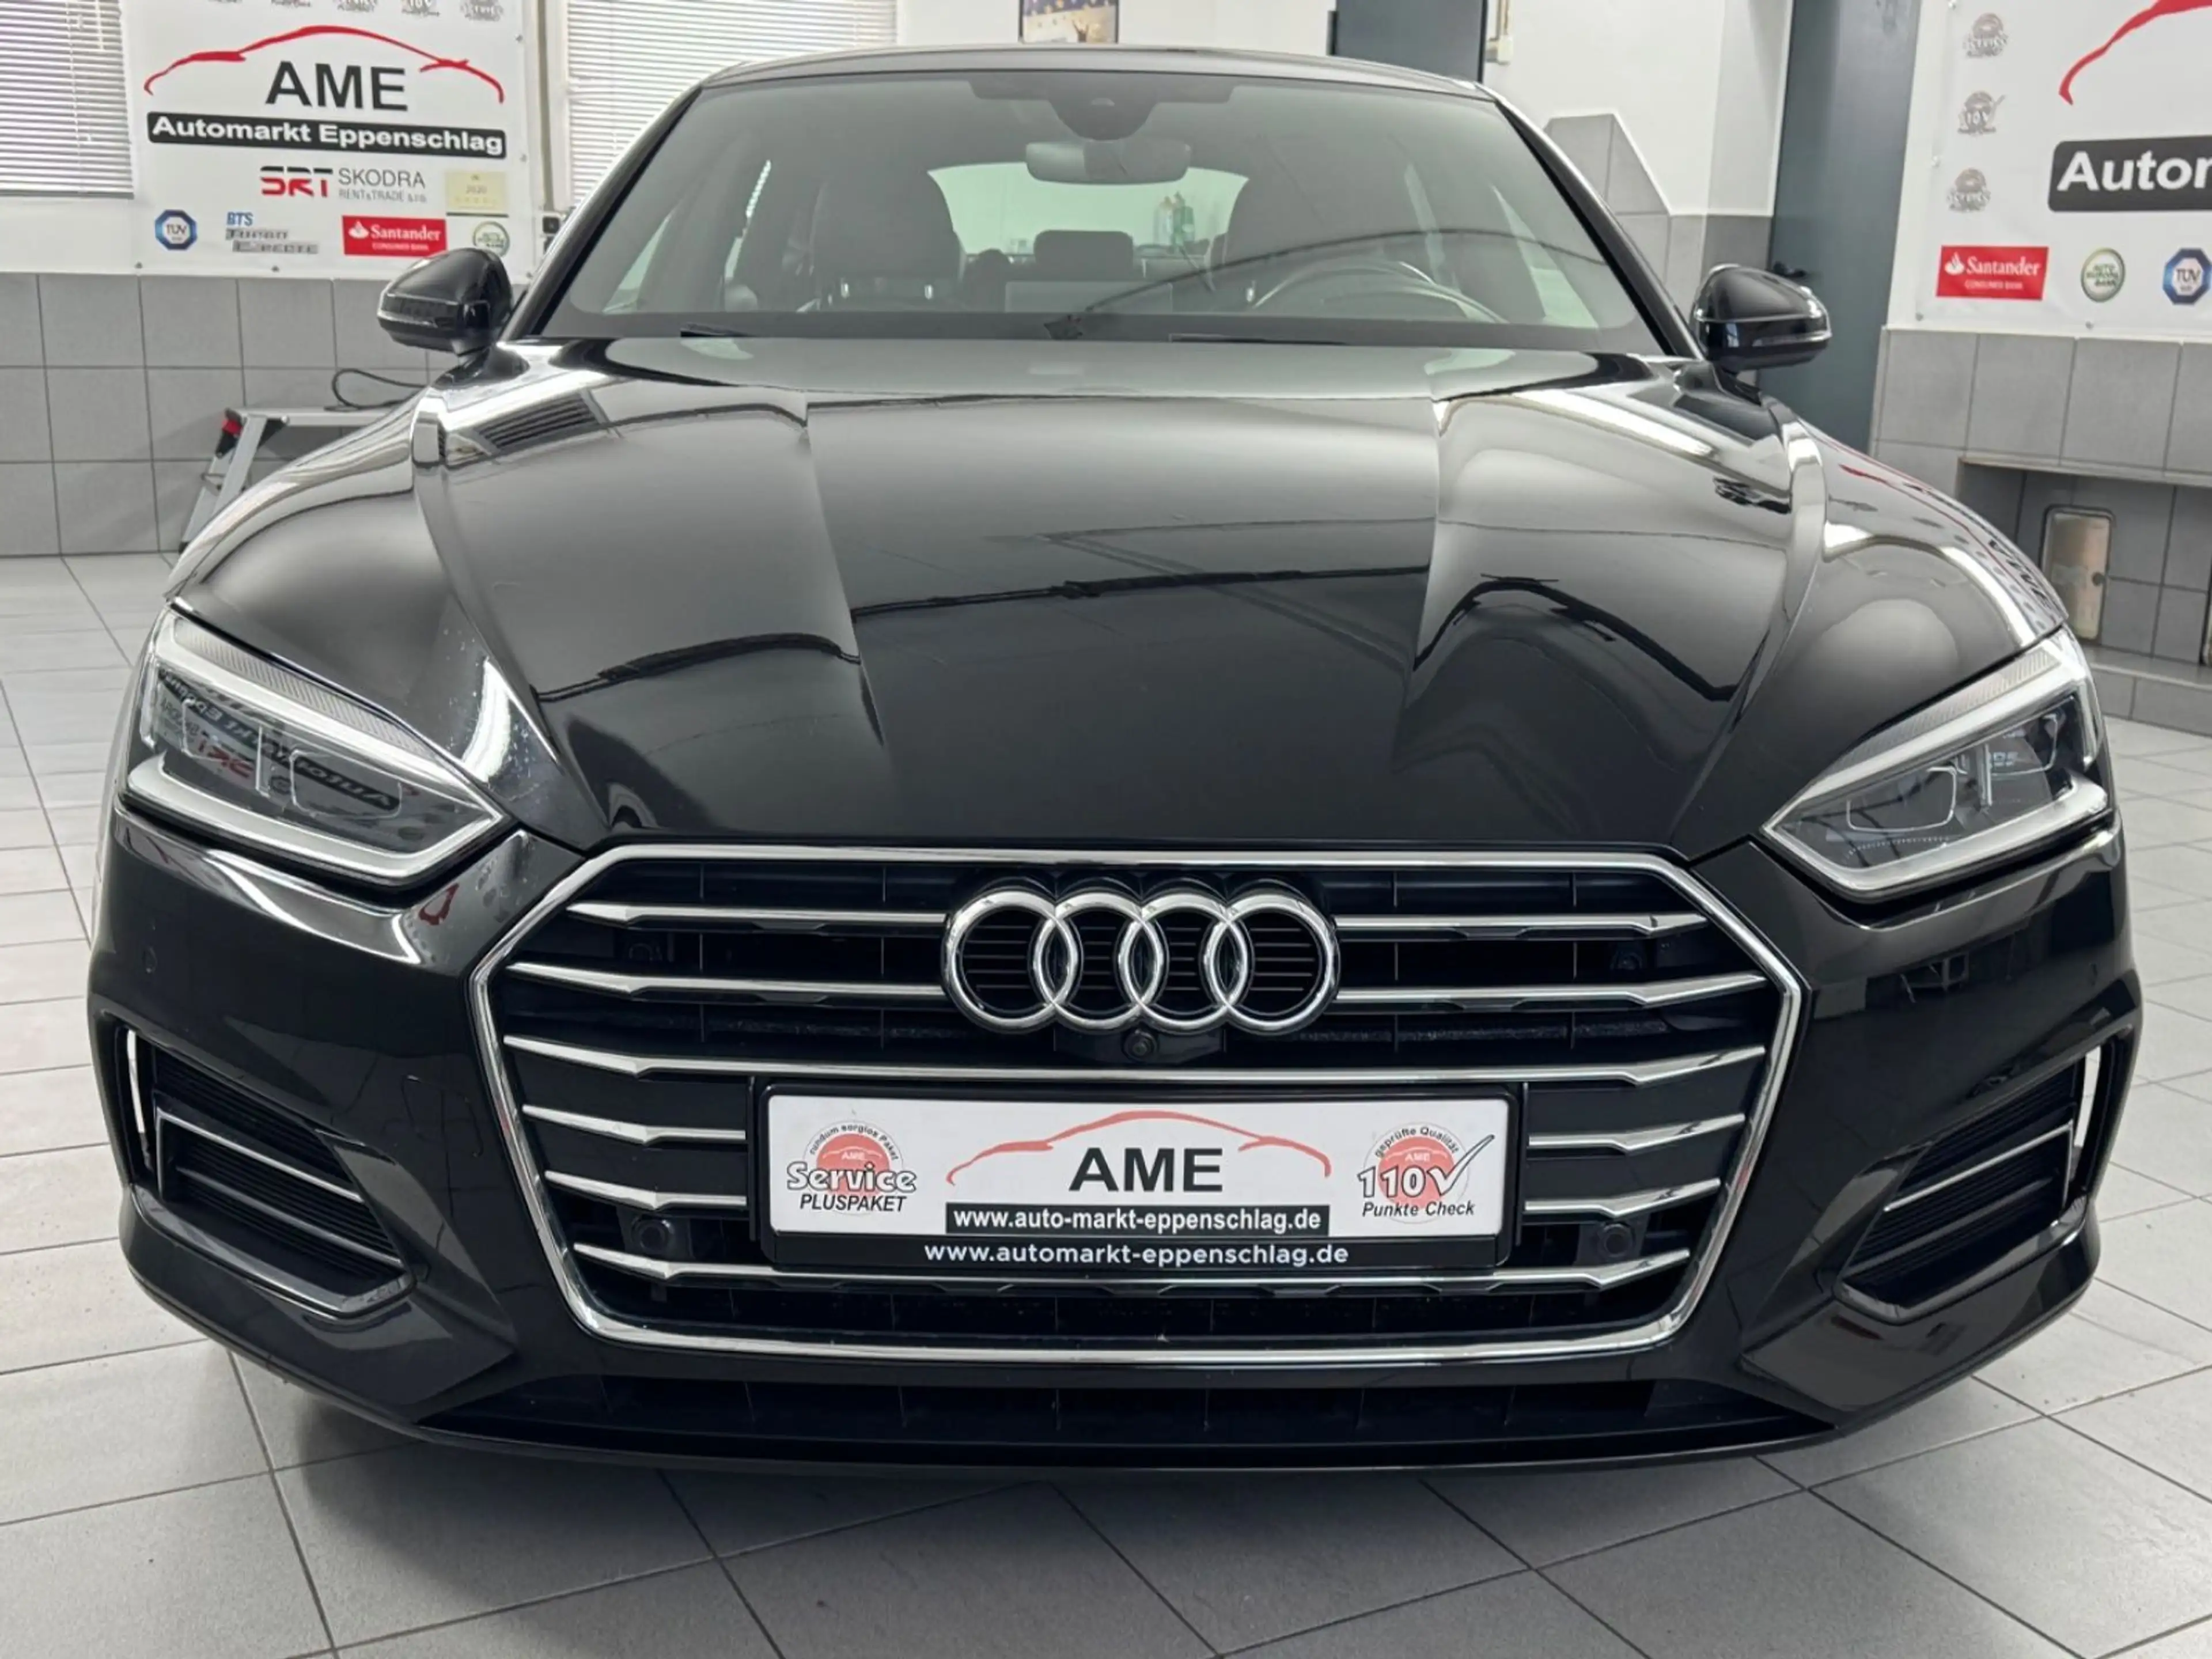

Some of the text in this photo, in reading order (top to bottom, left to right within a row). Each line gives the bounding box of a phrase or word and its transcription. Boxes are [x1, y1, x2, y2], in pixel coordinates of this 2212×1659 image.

[266, 60, 408, 112] AME
[153, 116, 503, 156] Automarkt Eppenschlag
[338, 167, 426, 189] SKODRA
[226, 211, 253, 226] BTS
[370, 224, 442, 241] Santander
[1966, 256, 2041, 276] Santander
[809, 1127, 839, 1156] rundum
[878, 1132, 899, 1161] Paket
[1419, 1126, 1460, 1154] Qualität
[786, 1160, 918, 1194] Service
[1069, 1147, 1223, 1192] AME
[800, 1193, 908, 1212] PLUSPAKET
[1362, 1199, 1476, 1217] Punkte Check
[953, 1208, 1322, 1234] www.auto-markt-eppenschlag.de
[924, 1242, 1349, 1268] www.automarkt-eppenschlag.de
